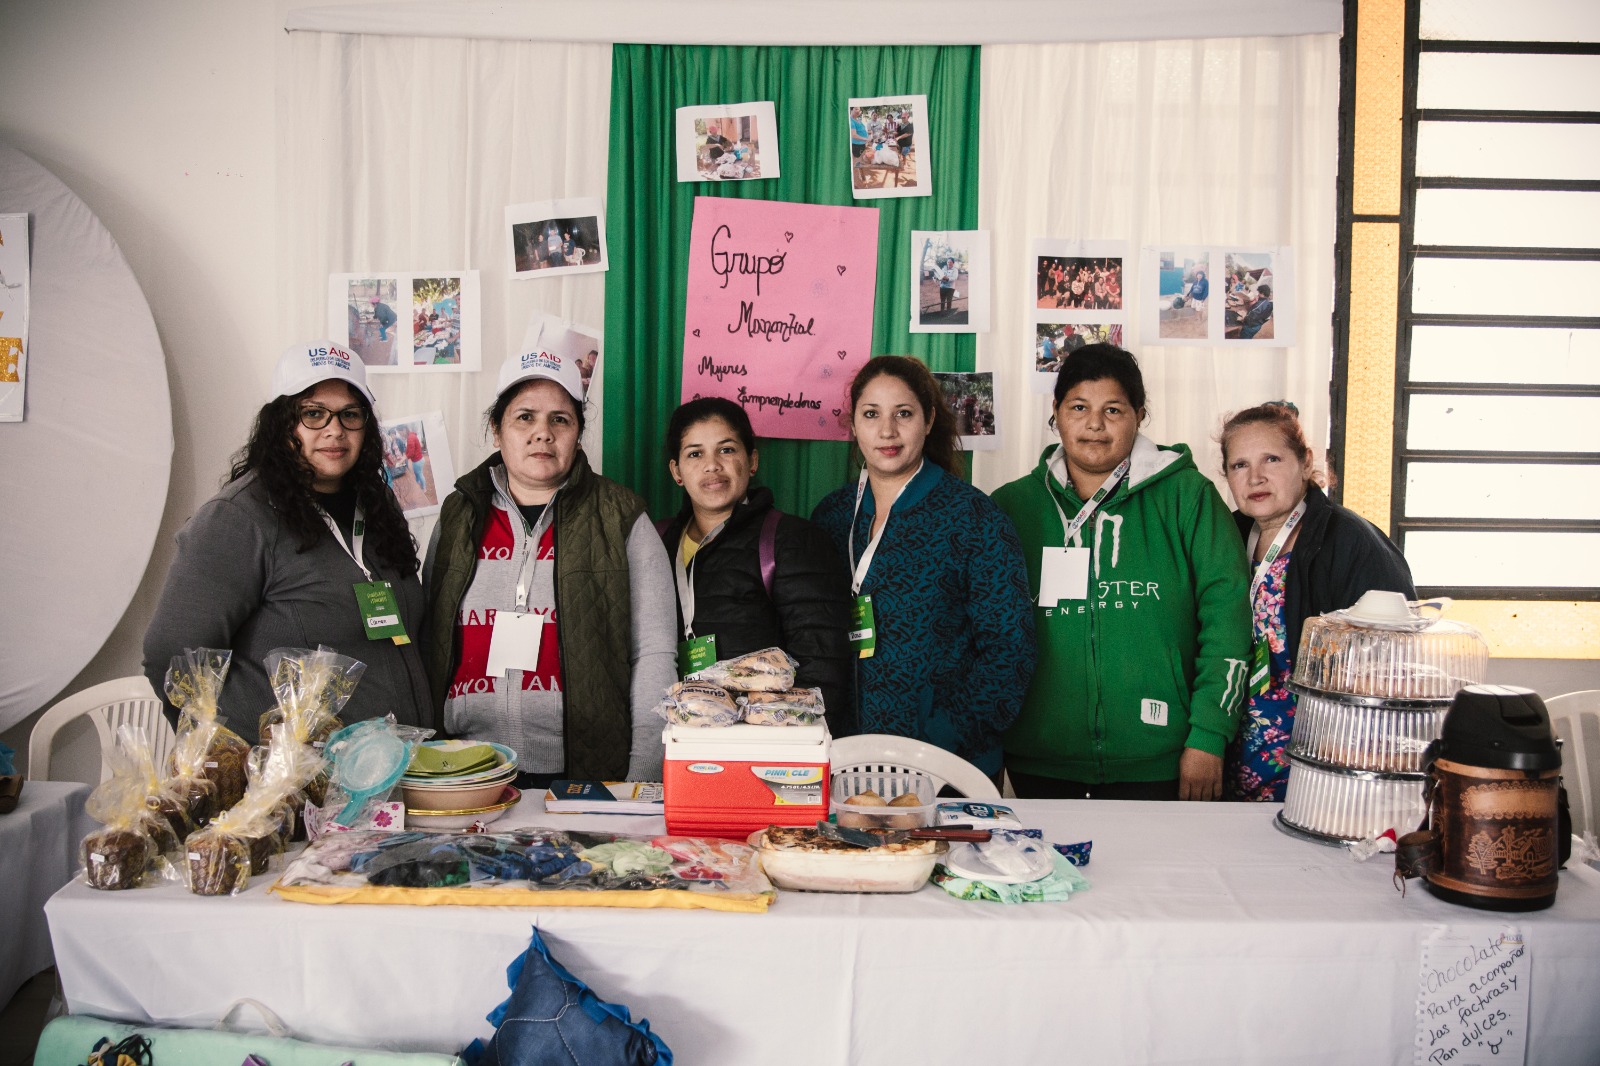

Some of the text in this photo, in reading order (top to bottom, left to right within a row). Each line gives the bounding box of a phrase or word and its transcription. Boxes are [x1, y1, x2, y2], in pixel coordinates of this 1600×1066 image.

[308, 347, 350, 360] USAID
[521, 351, 562, 363] USAID
[1045, 601, 1139, 617] ENERGY
[1427, 994, 1466, 1020] Para
